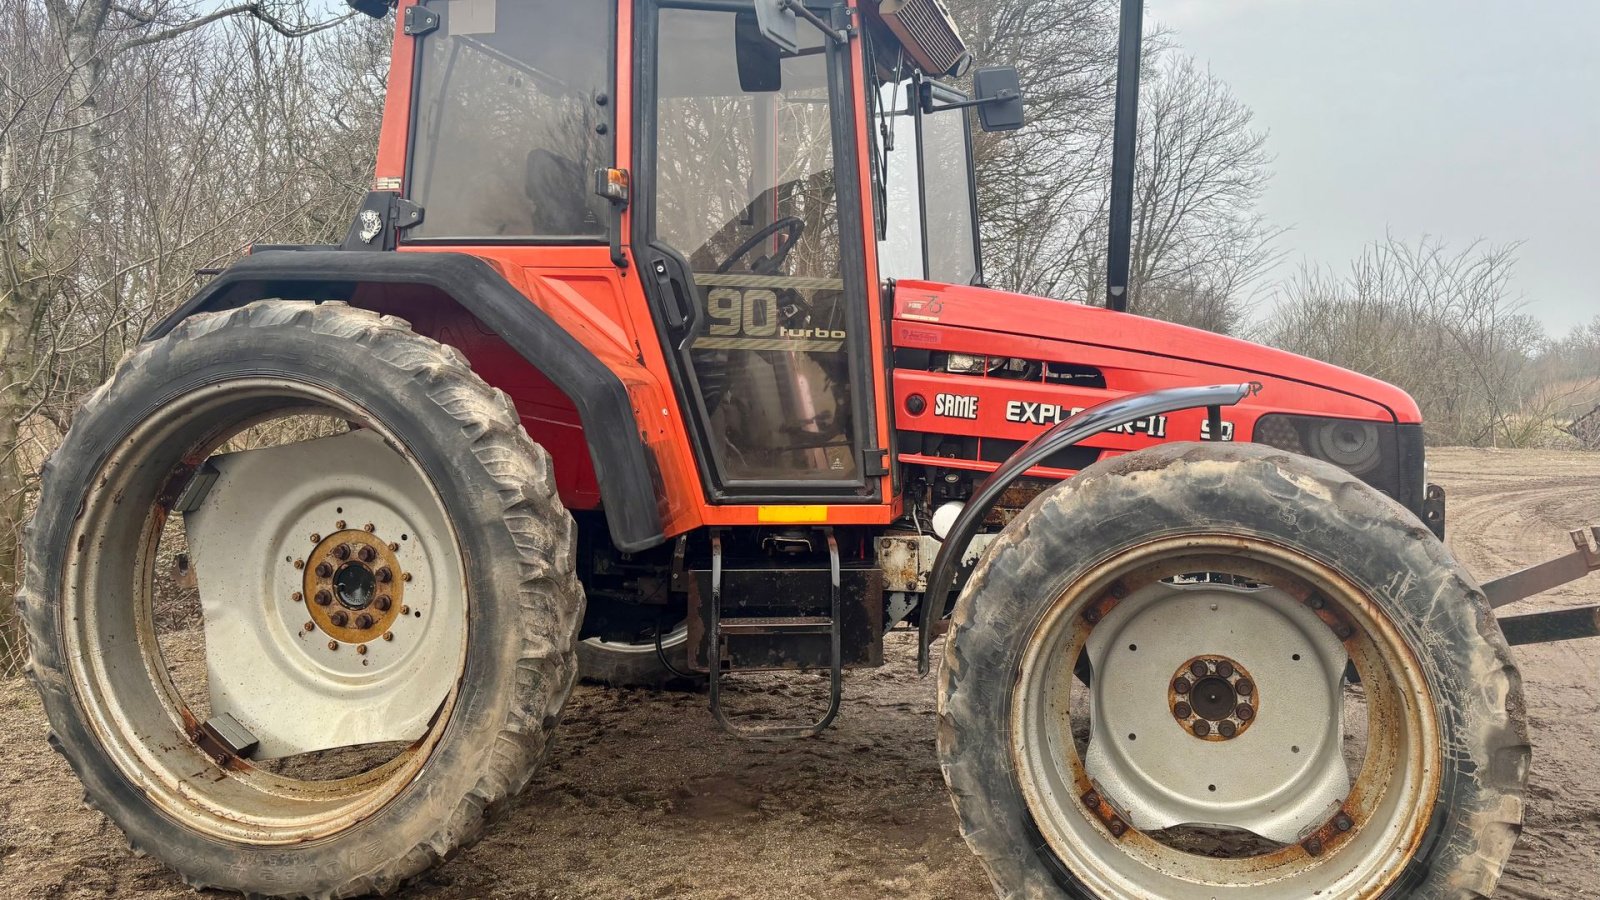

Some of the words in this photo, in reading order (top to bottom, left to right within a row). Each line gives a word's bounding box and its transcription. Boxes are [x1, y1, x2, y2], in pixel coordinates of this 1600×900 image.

[707, 288, 777, 337] 90
[779, 326, 846, 339] turbo
[934, 393, 979, 420] SAME
